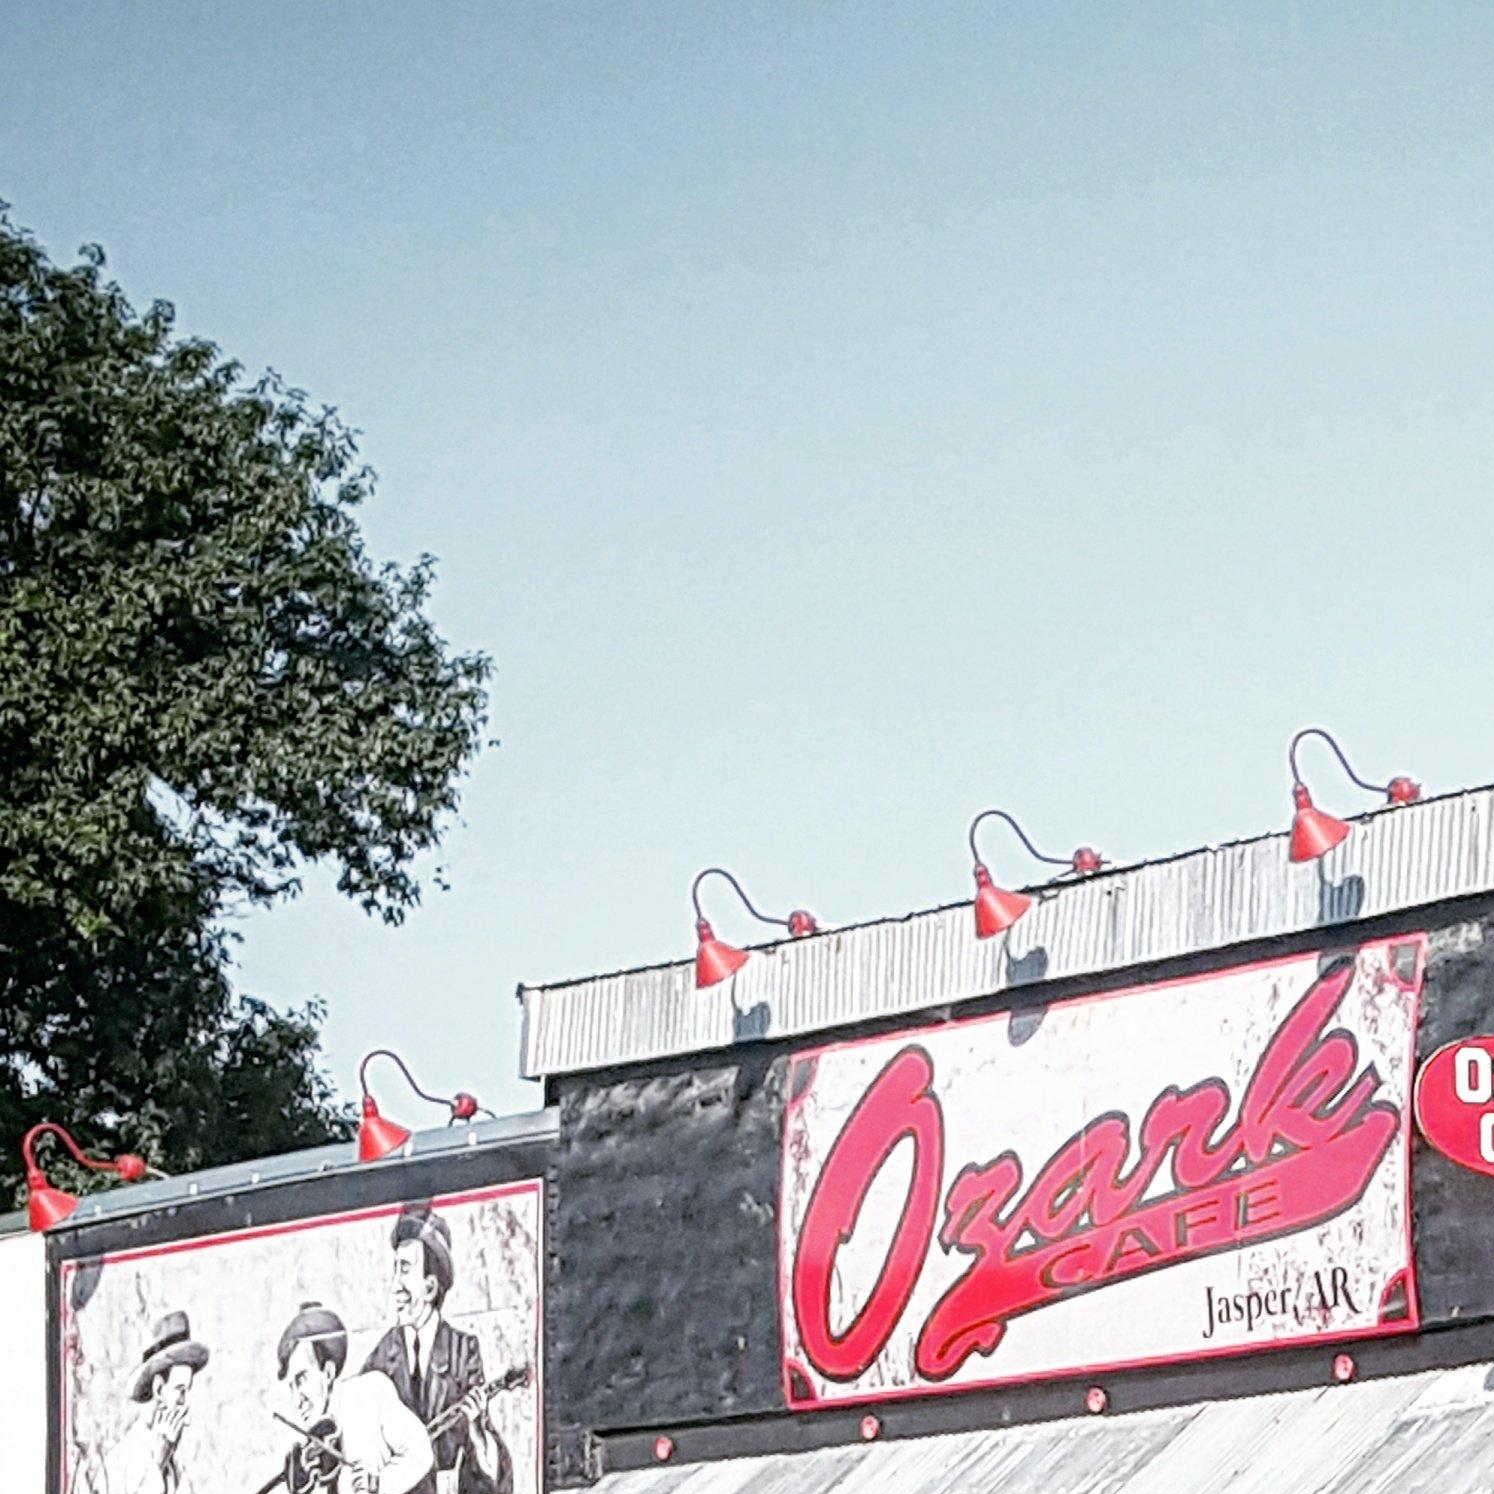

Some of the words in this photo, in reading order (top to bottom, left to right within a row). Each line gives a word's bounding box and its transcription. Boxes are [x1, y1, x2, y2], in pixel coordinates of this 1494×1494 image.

[793, 965, 1400, 1380] Ozark
[1038, 1178, 1282, 1290] CAFE
[1305, 1266, 1362, 1314] AR
